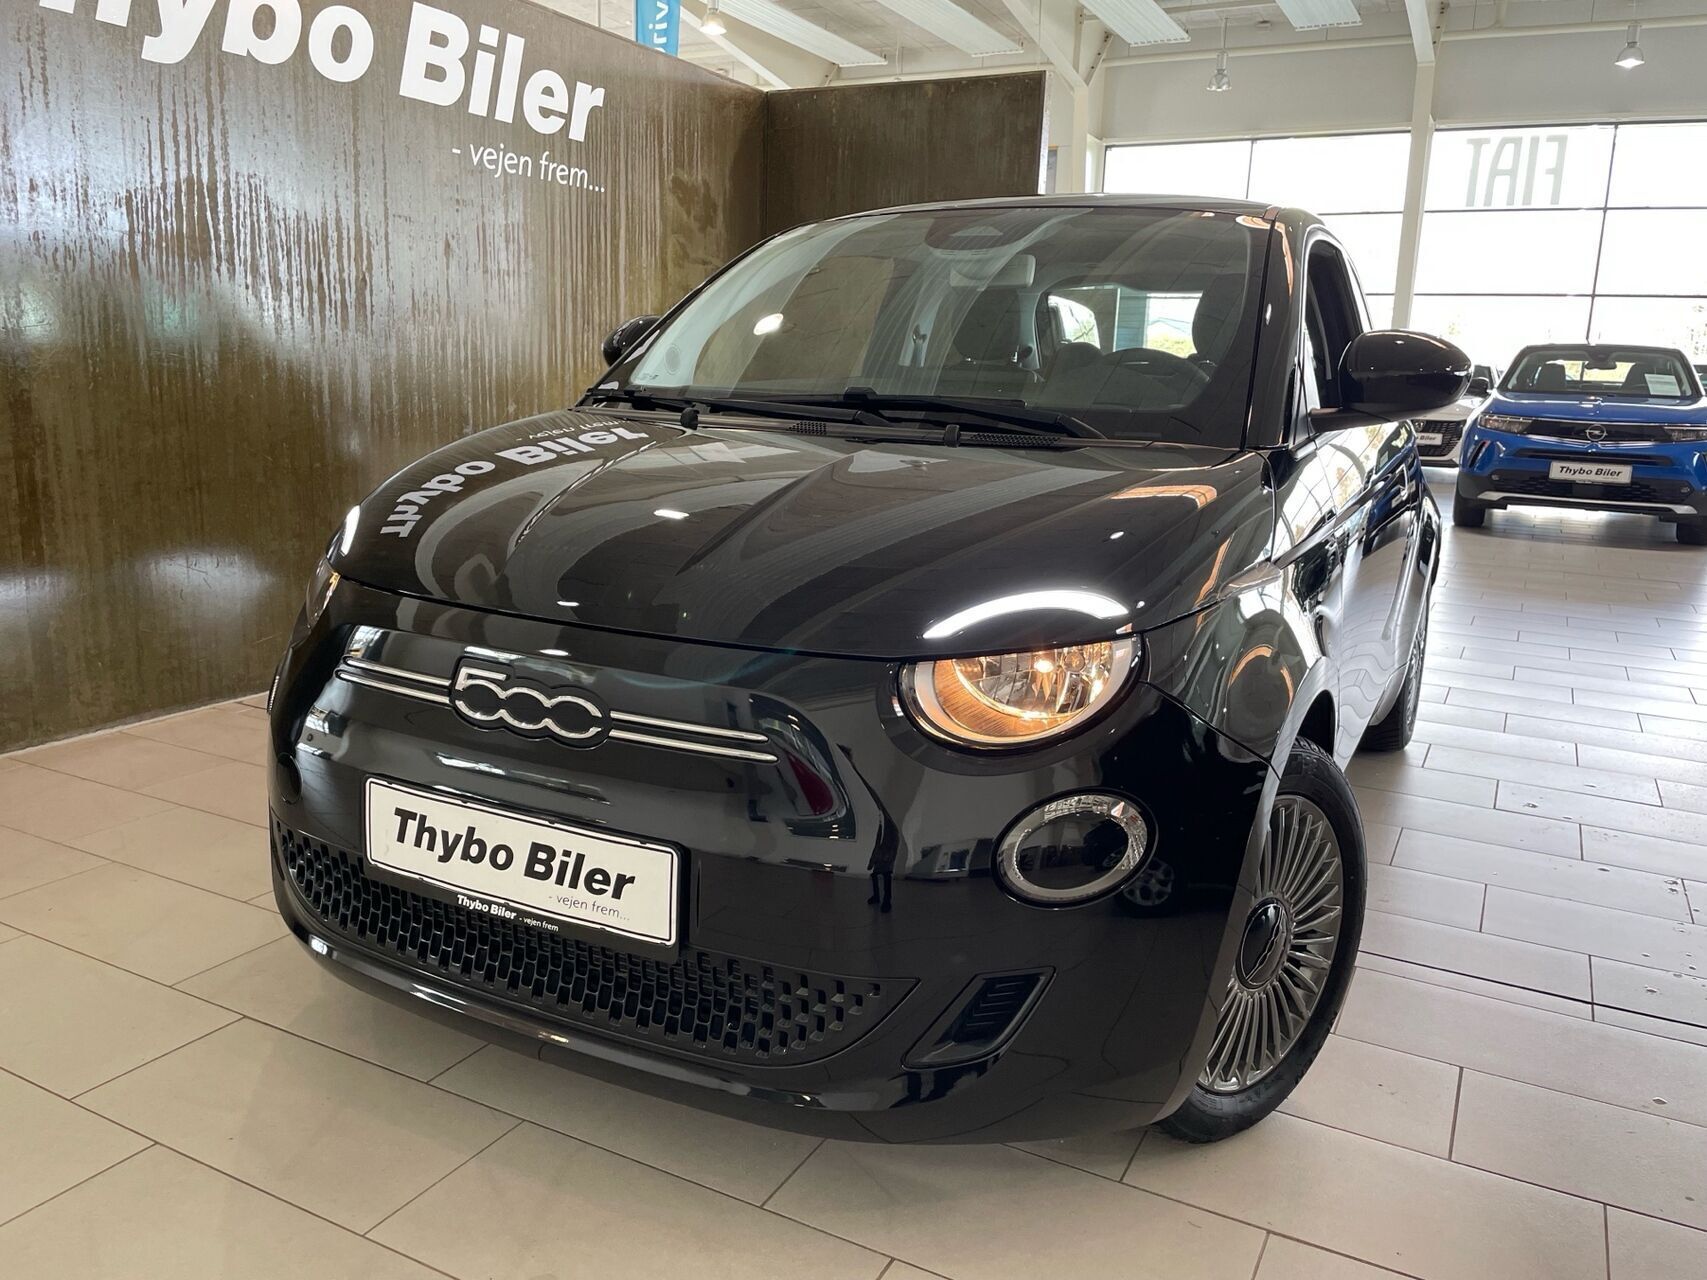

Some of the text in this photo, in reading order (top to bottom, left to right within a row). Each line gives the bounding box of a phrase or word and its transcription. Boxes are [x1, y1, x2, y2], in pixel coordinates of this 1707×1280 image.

[648, 0, 669, 53] riv
[399, 1, 606, 143] Biler
[470, 143, 532, 178] vejen
[539, 151, 605, 193] frem...
[1559, 466, 1622, 477] Thybo Biler
[455, 666, 603, 739] 500
[394, 806, 636, 900] Thybo Biler
[457, 894, 489, 913] Thybo
[490, 903, 518, 920] Biler
[523, 916, 542, 929] vejen
[542, 921, 560, 933] frem
[556, 894, 589, 911] vejen
[592, 901, 631, 922] frem...
